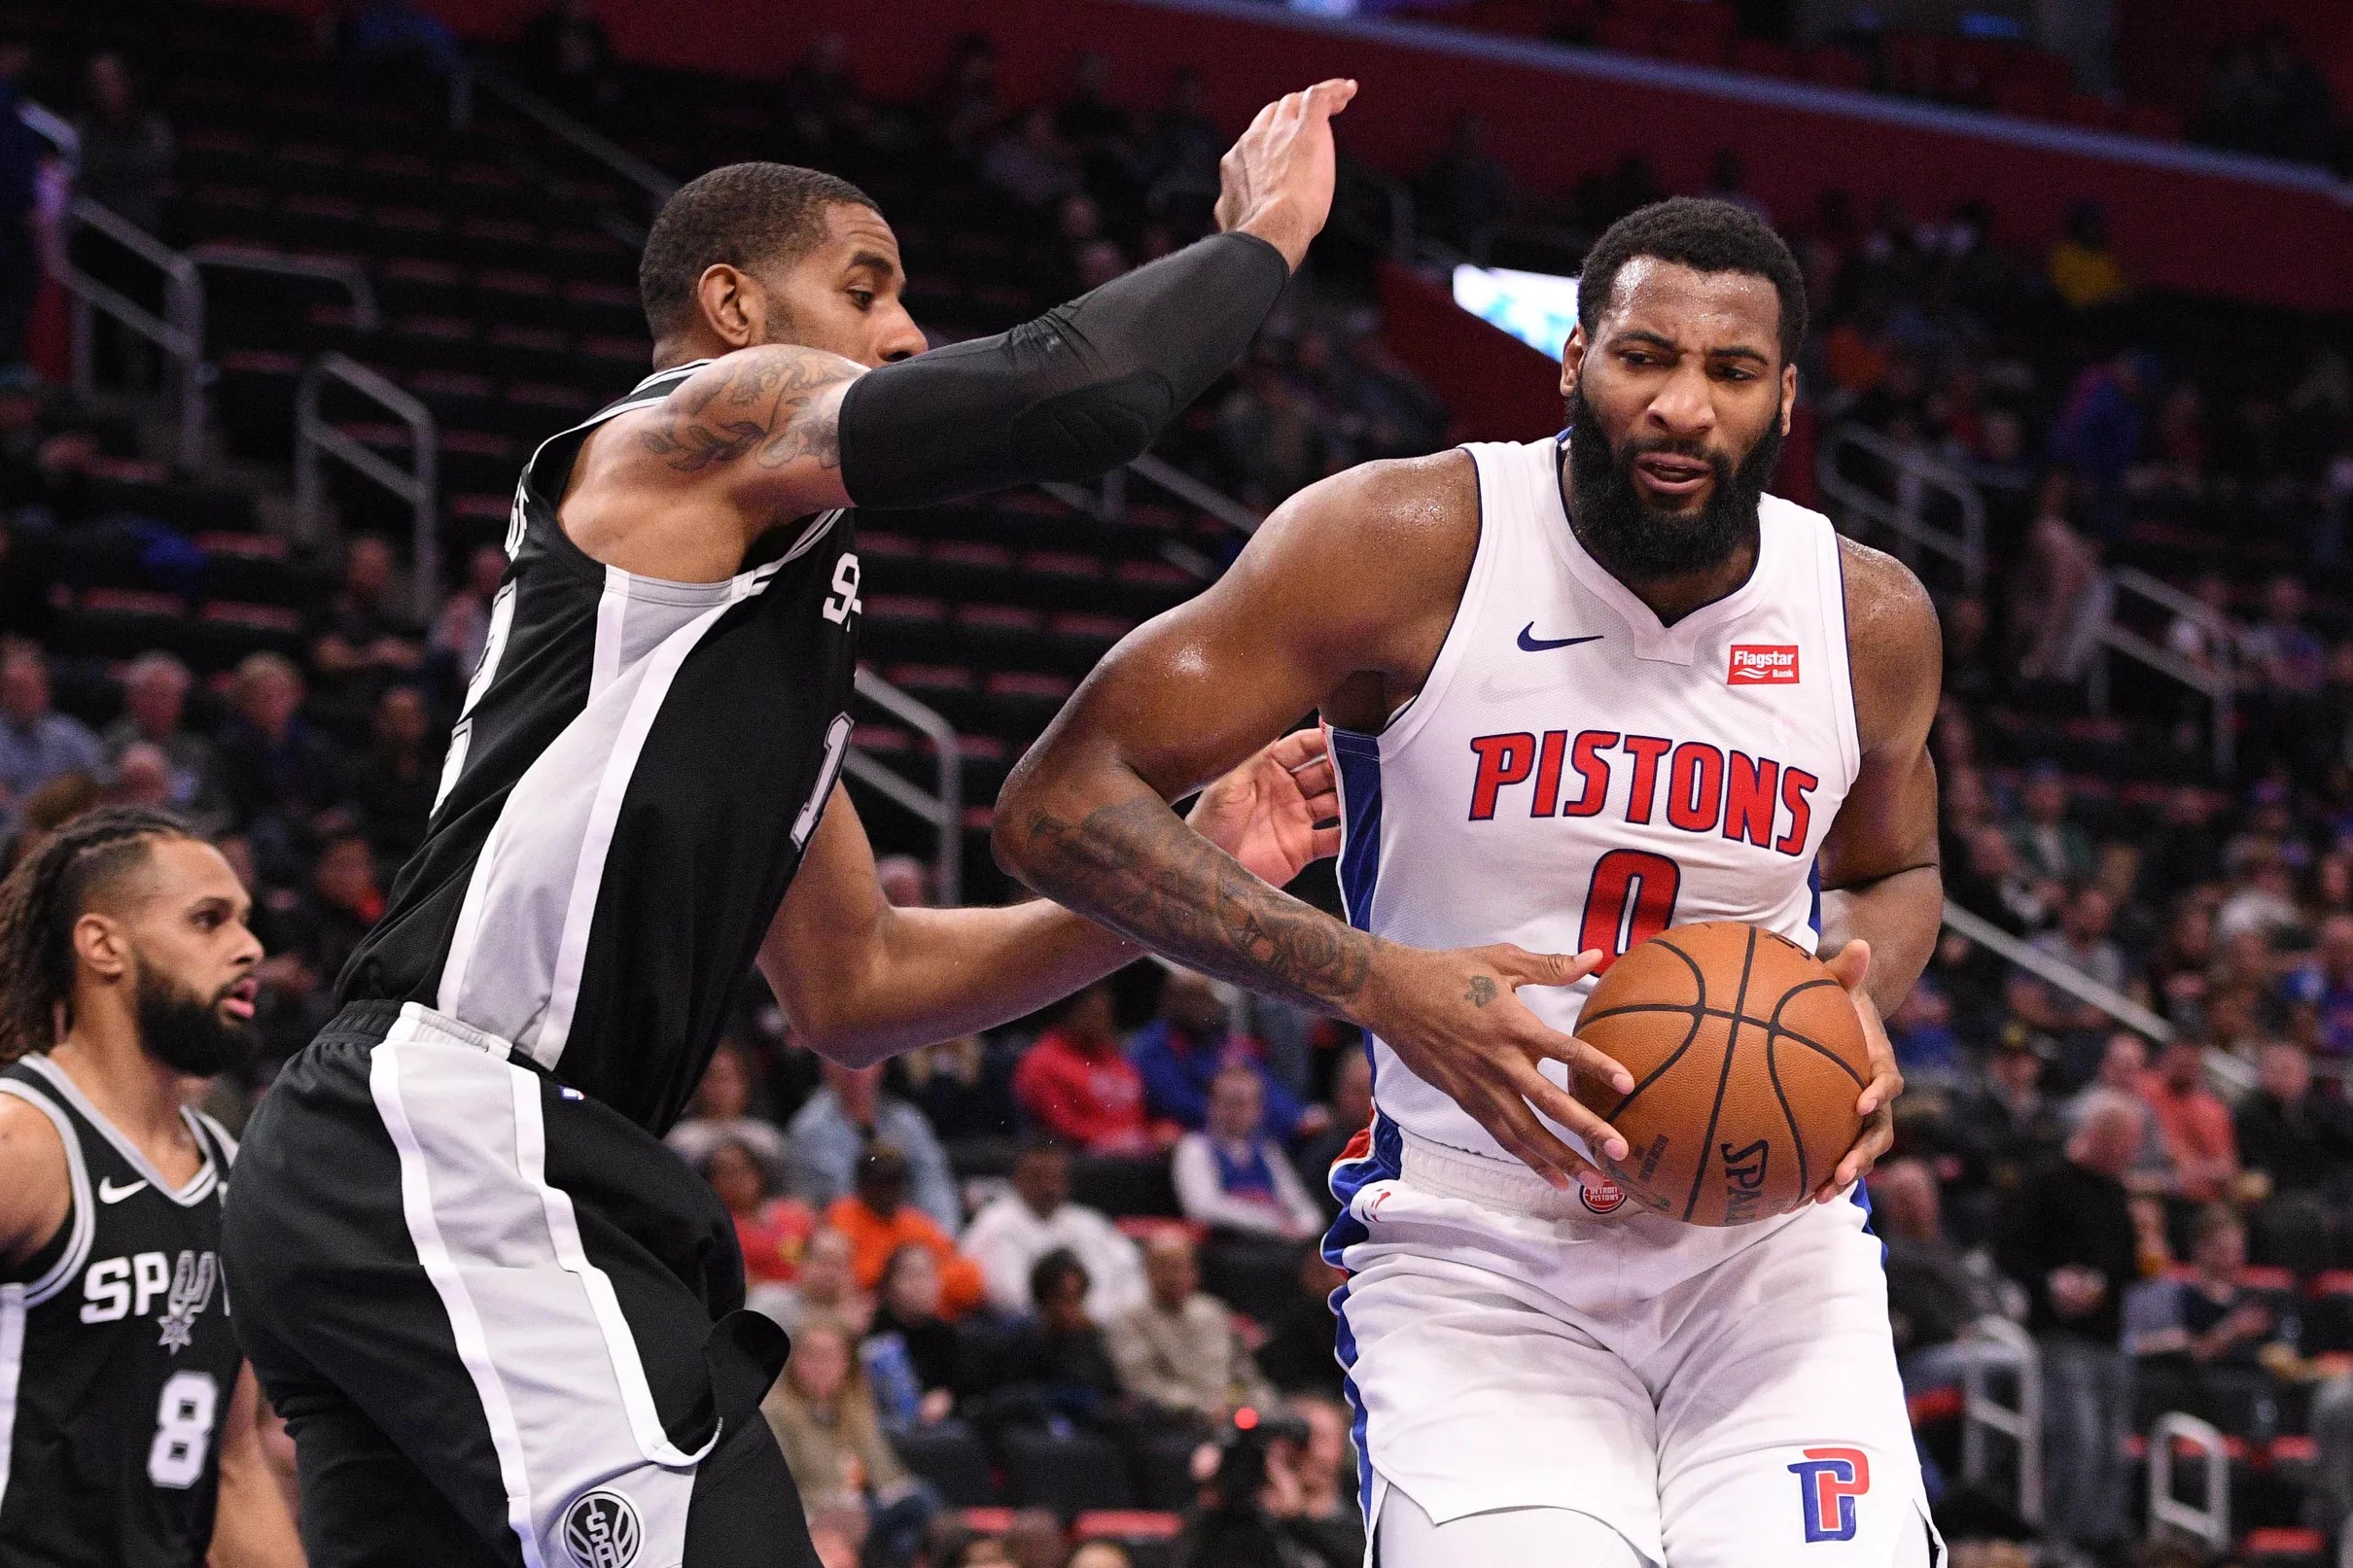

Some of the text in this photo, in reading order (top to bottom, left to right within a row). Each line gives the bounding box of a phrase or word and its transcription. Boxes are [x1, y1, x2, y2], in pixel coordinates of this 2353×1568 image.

[1734, 650, 1795, 668] Flagstar
[1772, 669, 1794, 678] Bank
[1468, 729, 1819, 856] PISTONS
[1577, 848, 1681, 977] 0
[147, 1370, 220, 1489] 8
